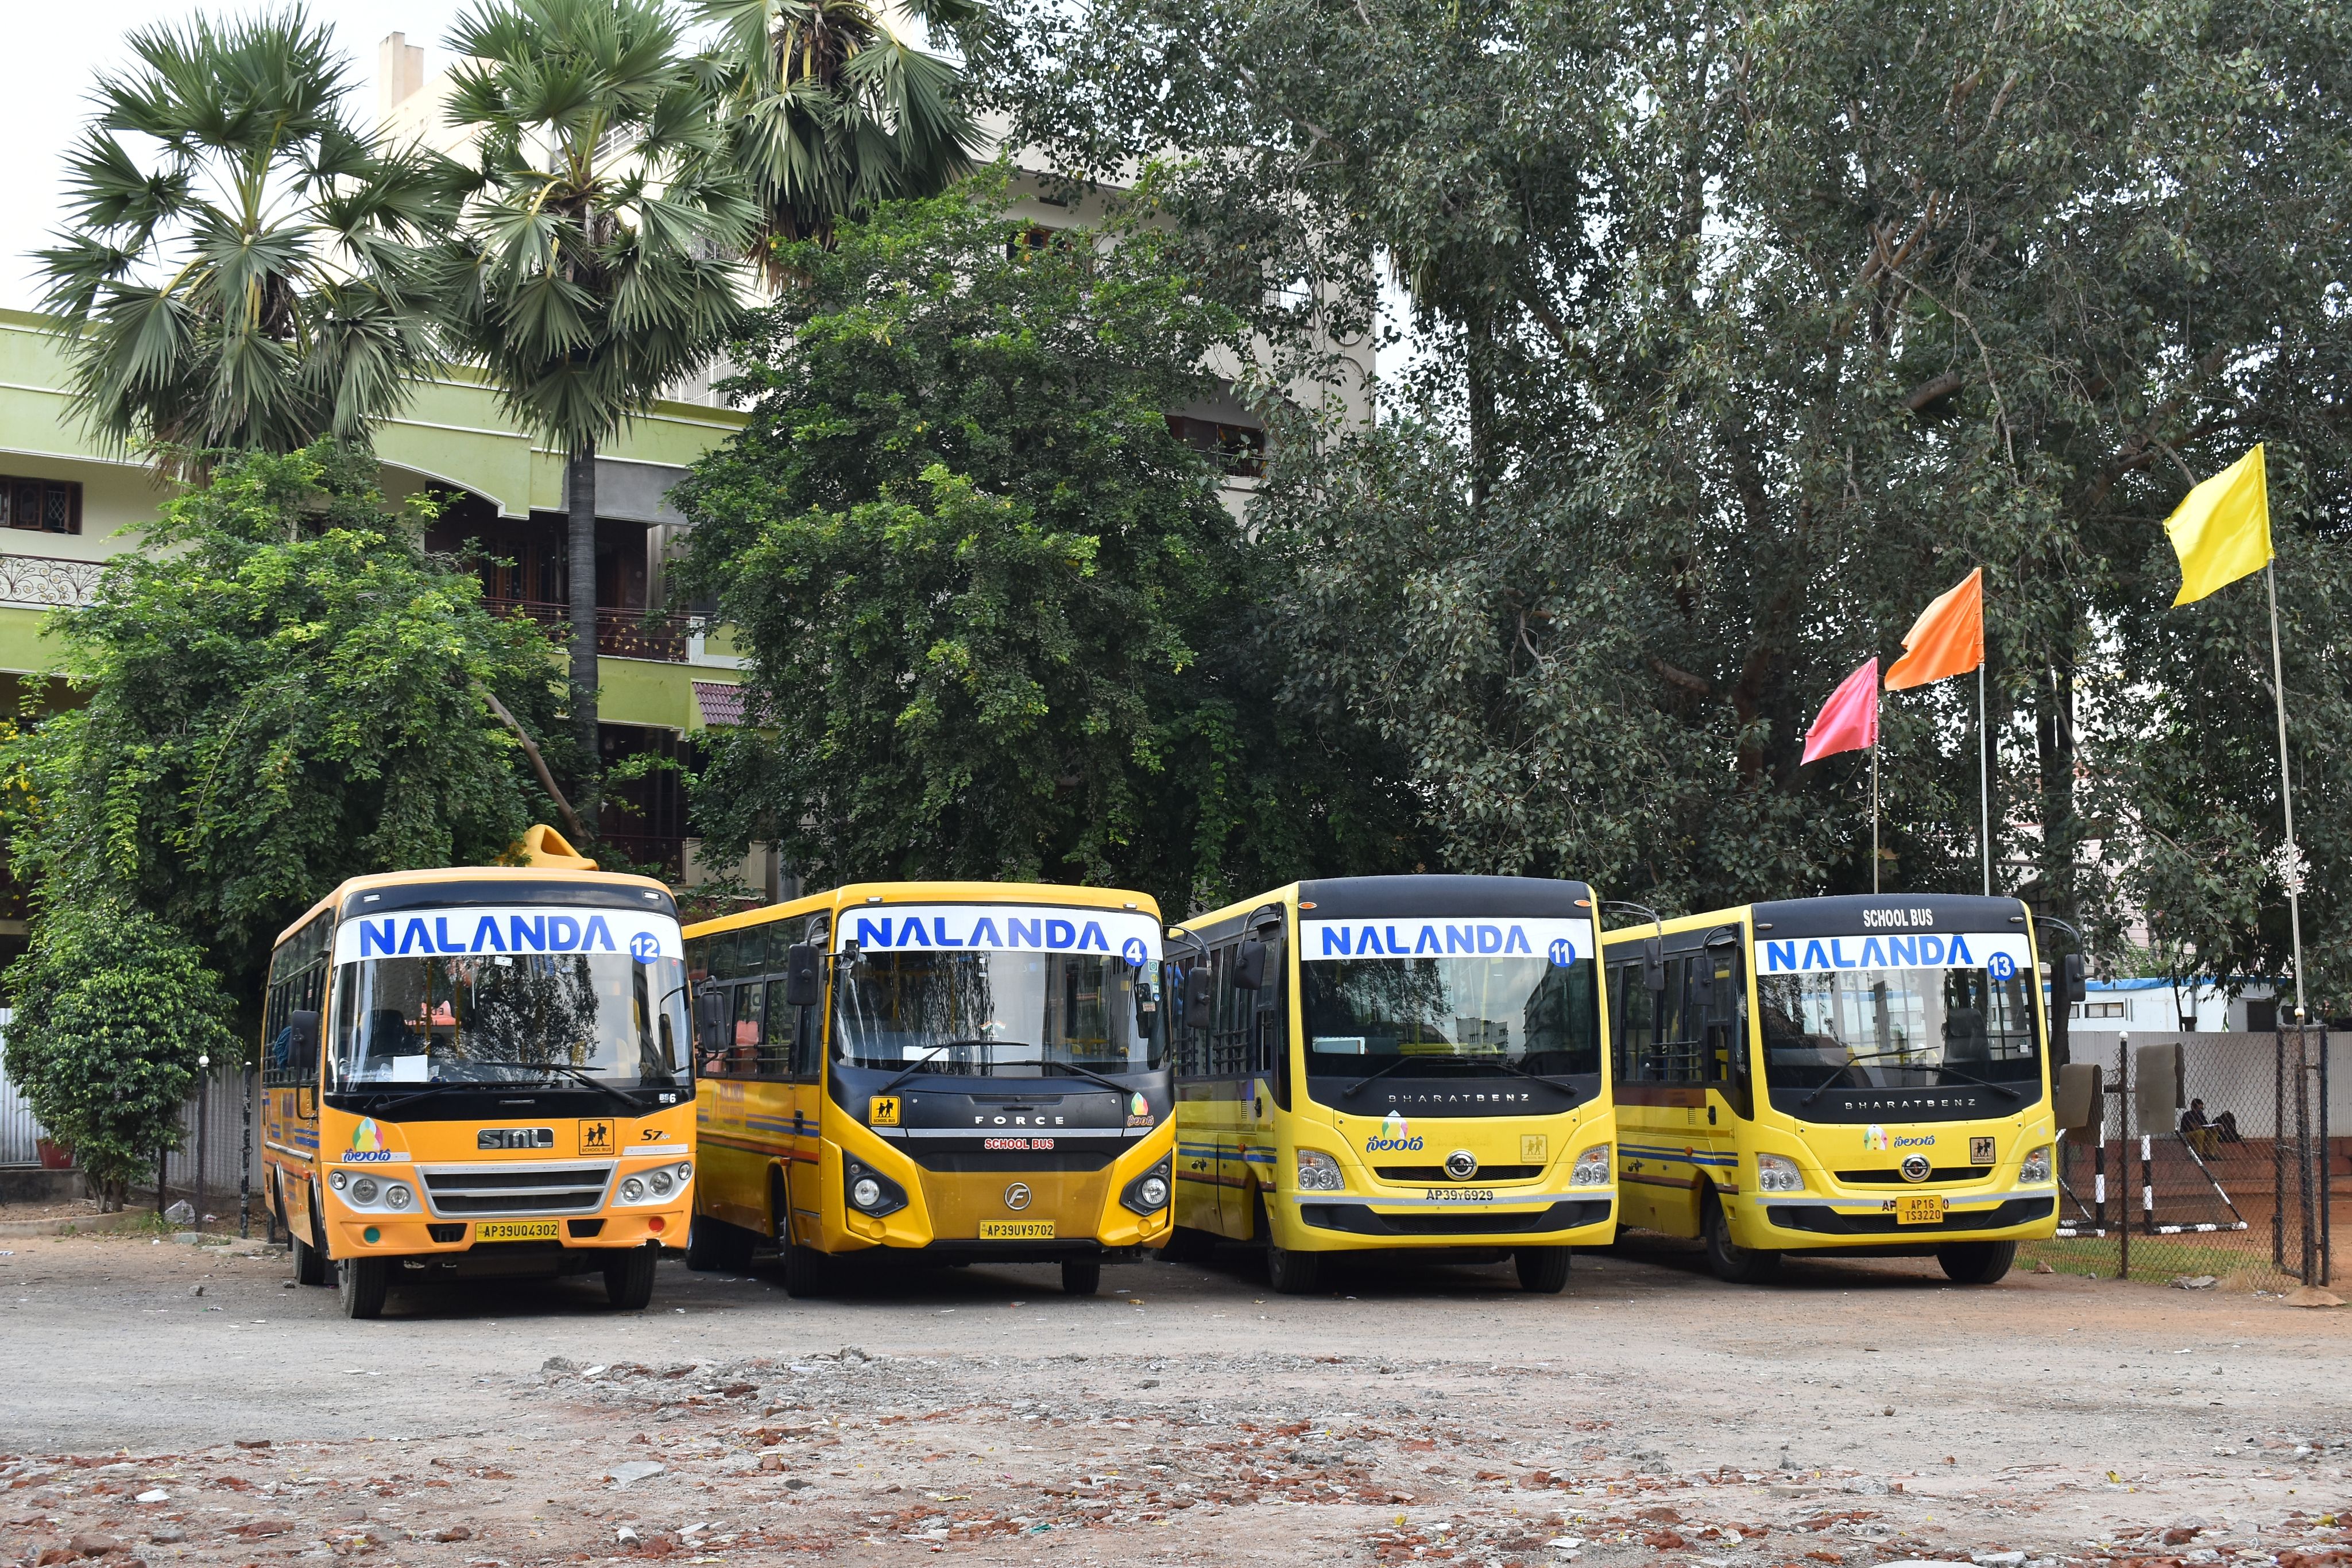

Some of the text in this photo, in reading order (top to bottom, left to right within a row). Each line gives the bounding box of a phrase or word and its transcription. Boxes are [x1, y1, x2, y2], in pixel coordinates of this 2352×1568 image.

[1863, 908, 1933, 927] SCHOOL BUS
[360, 915, 617, 957] NALANDA
[857, 917, 1110, 951] NALANDA
[1322, 925, 1532, 955] NALANDA
[630, 937, 659, 958] 12
[1125, 940, 1143, 962] 4
[1551, 942, 1570, 964] 11
[1767, 935, 1974, 971] NALANDA
[1989, 956, 2011, 976] 13
[1389, 1094, 1529, 1102] BHARATBENZ
[1845, 1099, 1976, 1109] BHARATBENZ
[975, 1116, 1064, 1125] FORCE
[1127, 1114, 1154, 1127] నలంద
[478, 1129, 553, 1148] SML
[640, 1129, 663, 1141] S7
[1894, 1135, 1935, 1148] నలంద
[985, 1139, 1054, 1149] SCHOOL BUS
[1366, 1135, 1424, 1153] నలంద
[343, 1148, 391, 1163] నలంద
[1426, 1190, 1494, 1201] AP39Y6929
[1905, 1209, 1941, 1221] TS3220
[484, 1224, 558, 1237] AP39UQ4302
[987, 1225, 1054, 1236] AP39UV9702
